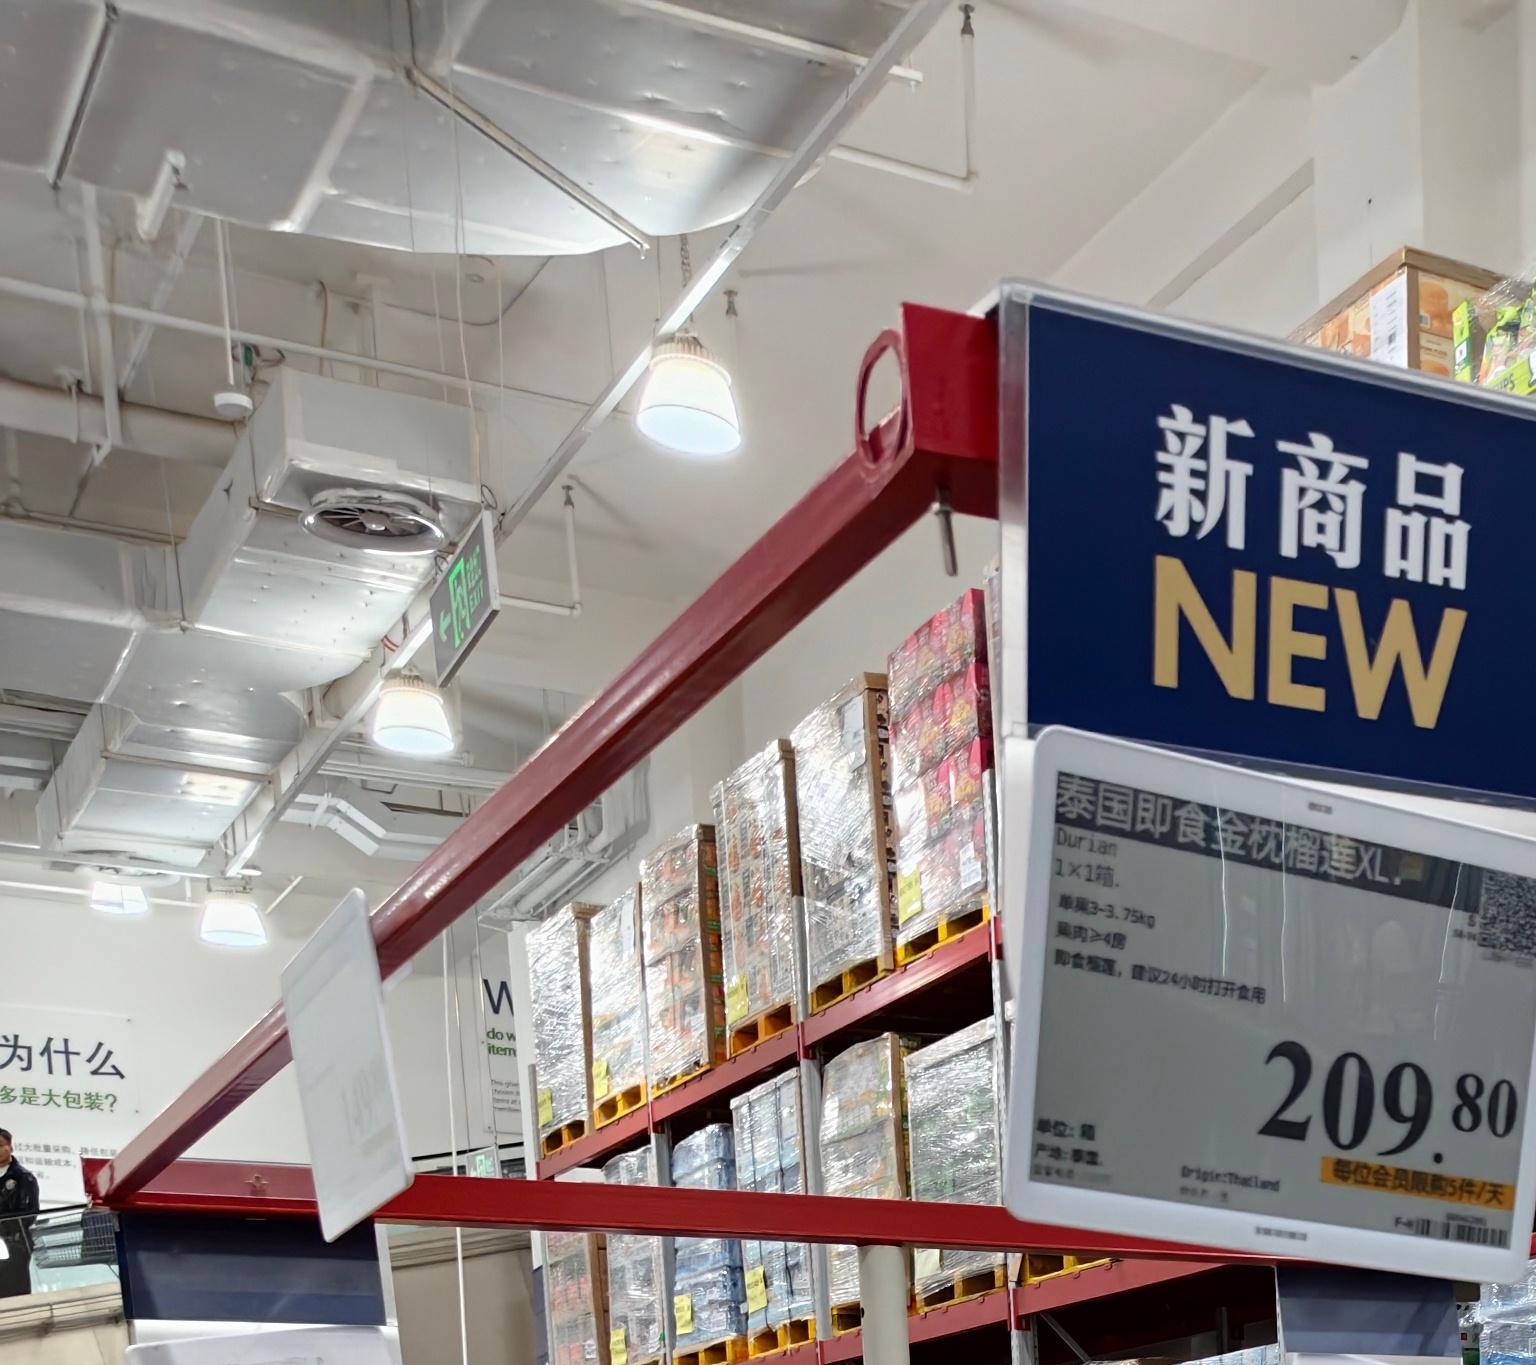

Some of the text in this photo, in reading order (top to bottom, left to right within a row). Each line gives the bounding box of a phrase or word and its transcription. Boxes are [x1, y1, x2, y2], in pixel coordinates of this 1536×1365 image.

[1155, 405, 1471, 589] 新商品
[1152, 555, 1467, 729] NEW
[1057, 827, 1117, 857] Durian
[0, 1034, 125, 1079] 为什么
